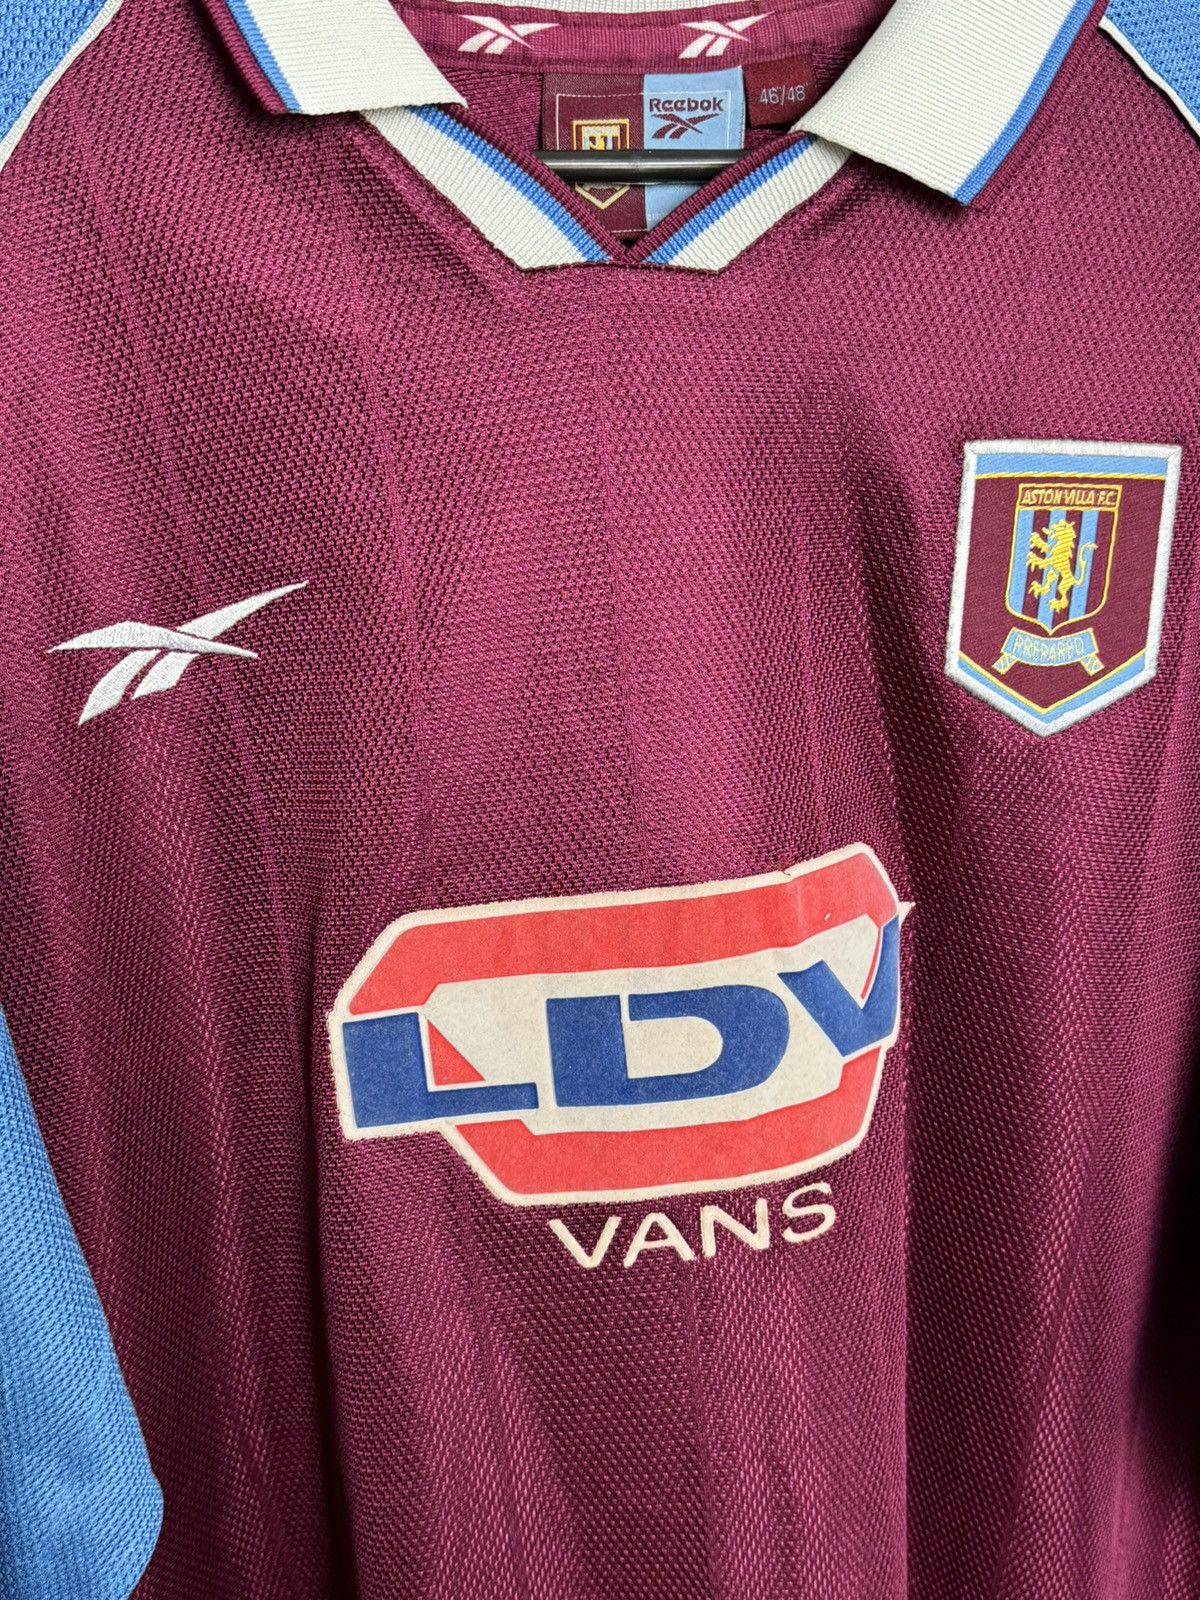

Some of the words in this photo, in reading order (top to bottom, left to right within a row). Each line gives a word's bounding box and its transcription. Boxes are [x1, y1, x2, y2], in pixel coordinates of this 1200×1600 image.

[649, 97, 724, 112] Reebok
[1021, 488, 1062, 505] ASTON
[1064, 489, 1094, 505] VILLA
[342, 913, 900, 1128] LDV
[549, 1182, 836, 1268] VANS
